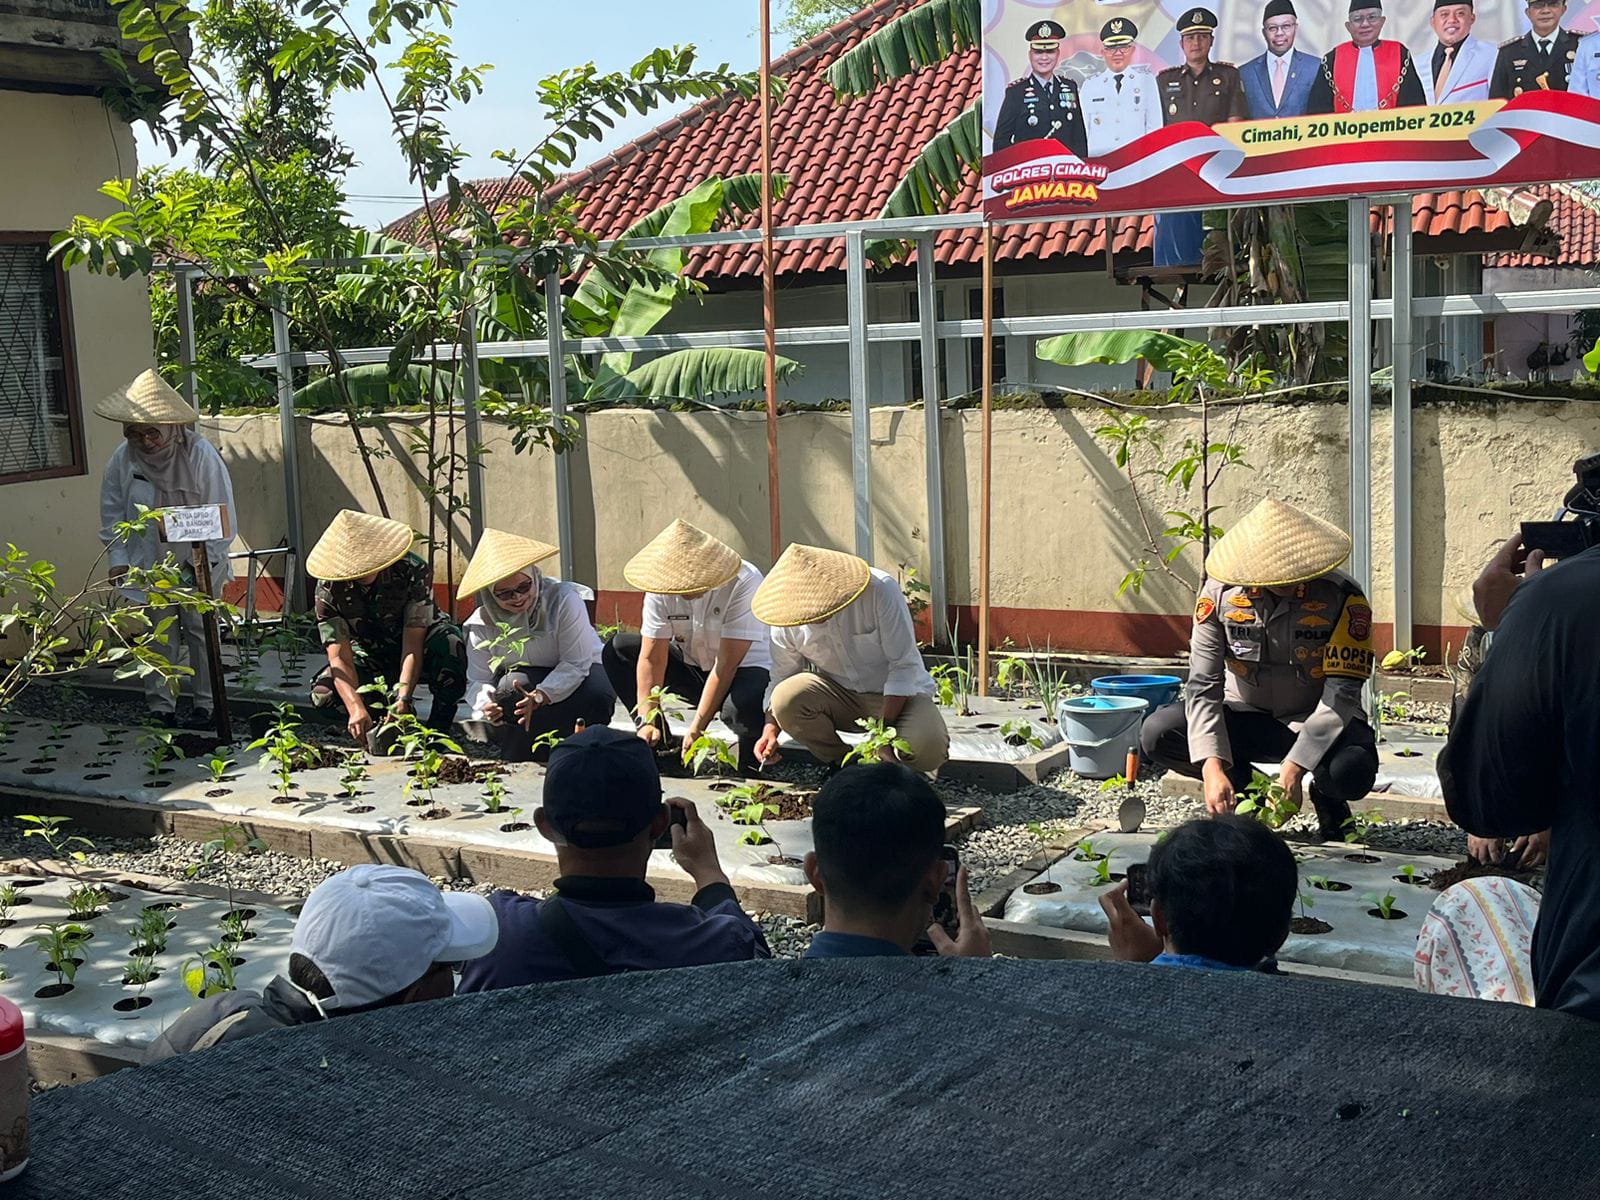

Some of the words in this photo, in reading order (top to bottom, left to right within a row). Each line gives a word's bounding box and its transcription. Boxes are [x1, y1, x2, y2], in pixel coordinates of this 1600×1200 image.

[1241, 124, 1303, 144] Cimahi,
[1307, 122, 1330, 138] 20
[1334, 116, 1425, 139] Nopember
[1429, 110, 1476, 129] 2024
[992, 165, 1051, 188] POLRES
[1055, 164, 1107, 179] CIMAHI
[1005, 181, 1098, 208] JAWARA
[1295, 629, 1330, 640] POLR
[1325, 645, 1338, 660] KA
[1341, 646, 1366, 664] OPS
